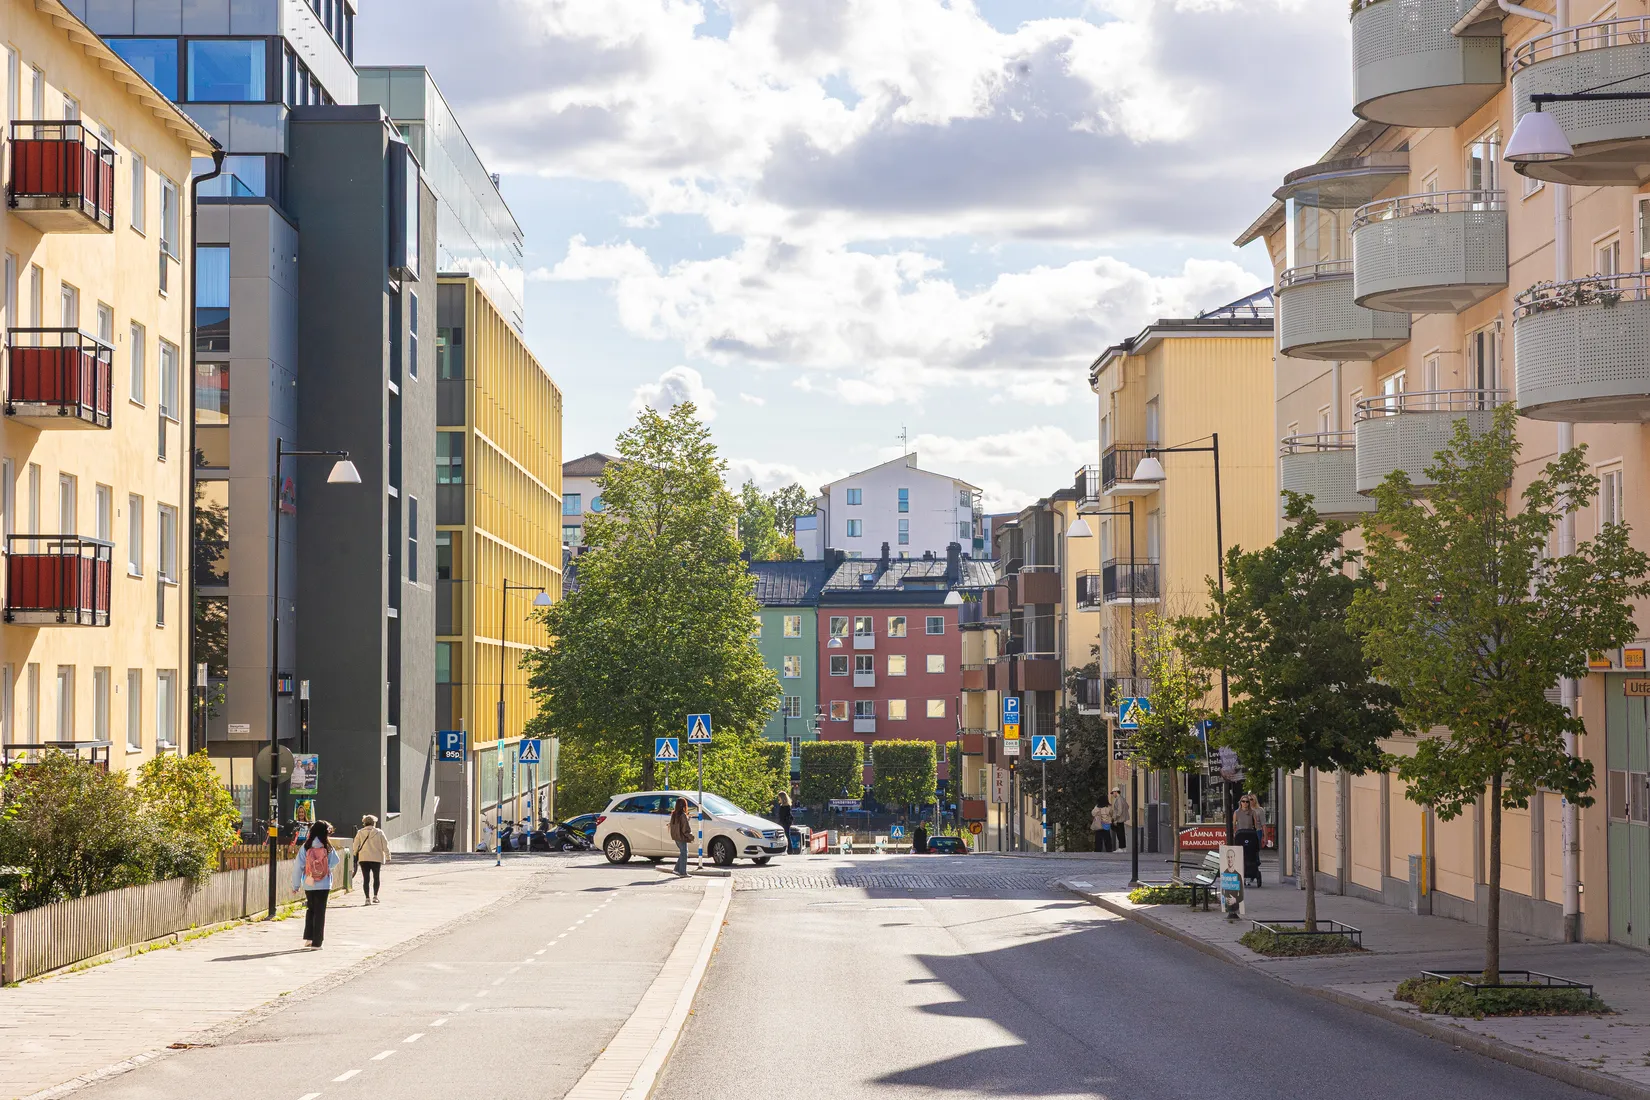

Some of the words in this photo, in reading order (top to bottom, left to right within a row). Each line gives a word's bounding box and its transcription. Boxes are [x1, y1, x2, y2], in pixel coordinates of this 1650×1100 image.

[1630, 682, 1650, 692] Utfa
[1008, 699, 1016, 711] P
[447, 733, 458, 748] P
